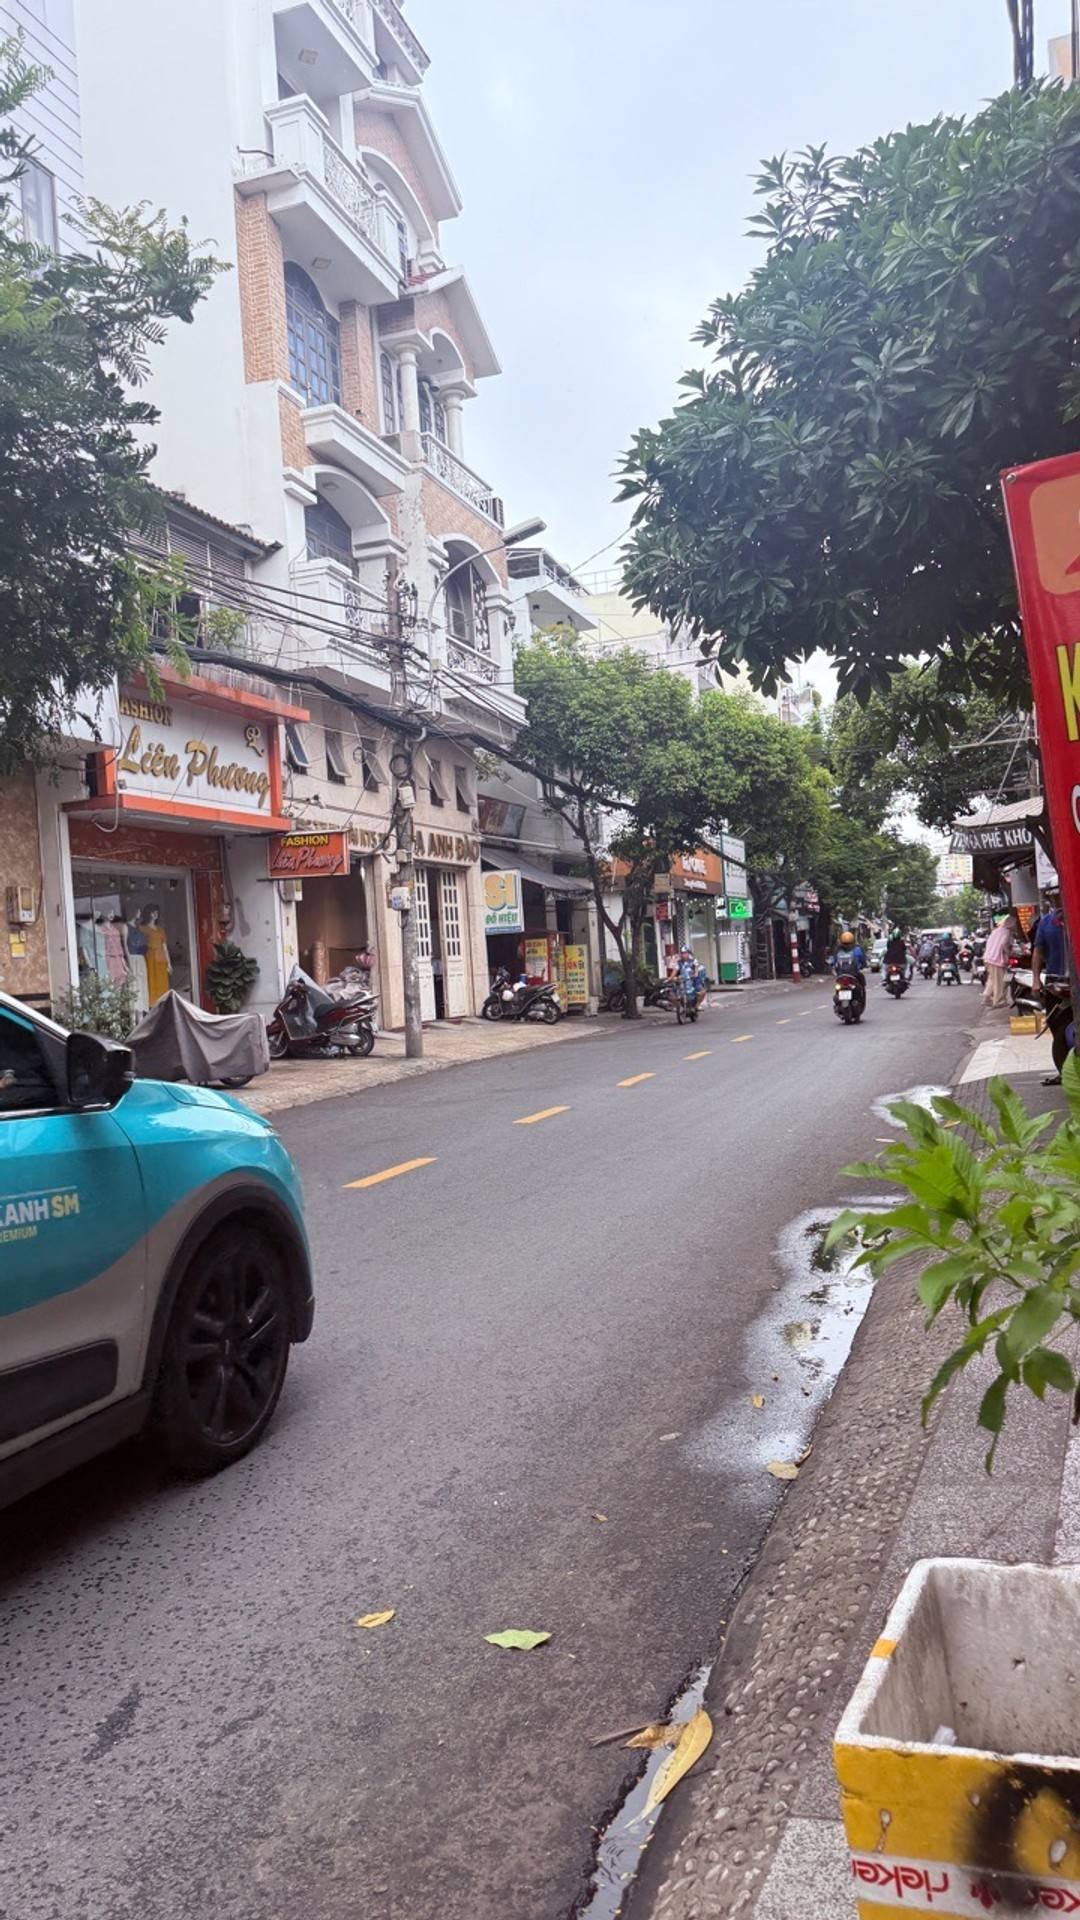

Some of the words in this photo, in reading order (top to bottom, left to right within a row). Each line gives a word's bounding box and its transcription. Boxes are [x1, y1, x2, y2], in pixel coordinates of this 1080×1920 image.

[117, 724, 181, 780] Liên
[281, 834, 329, 848] FASHION
[428, 832, 454, 859] ANH
[455, 835, 480, 863] ĐÀO
[51, 1193, 80, 1218] SM
